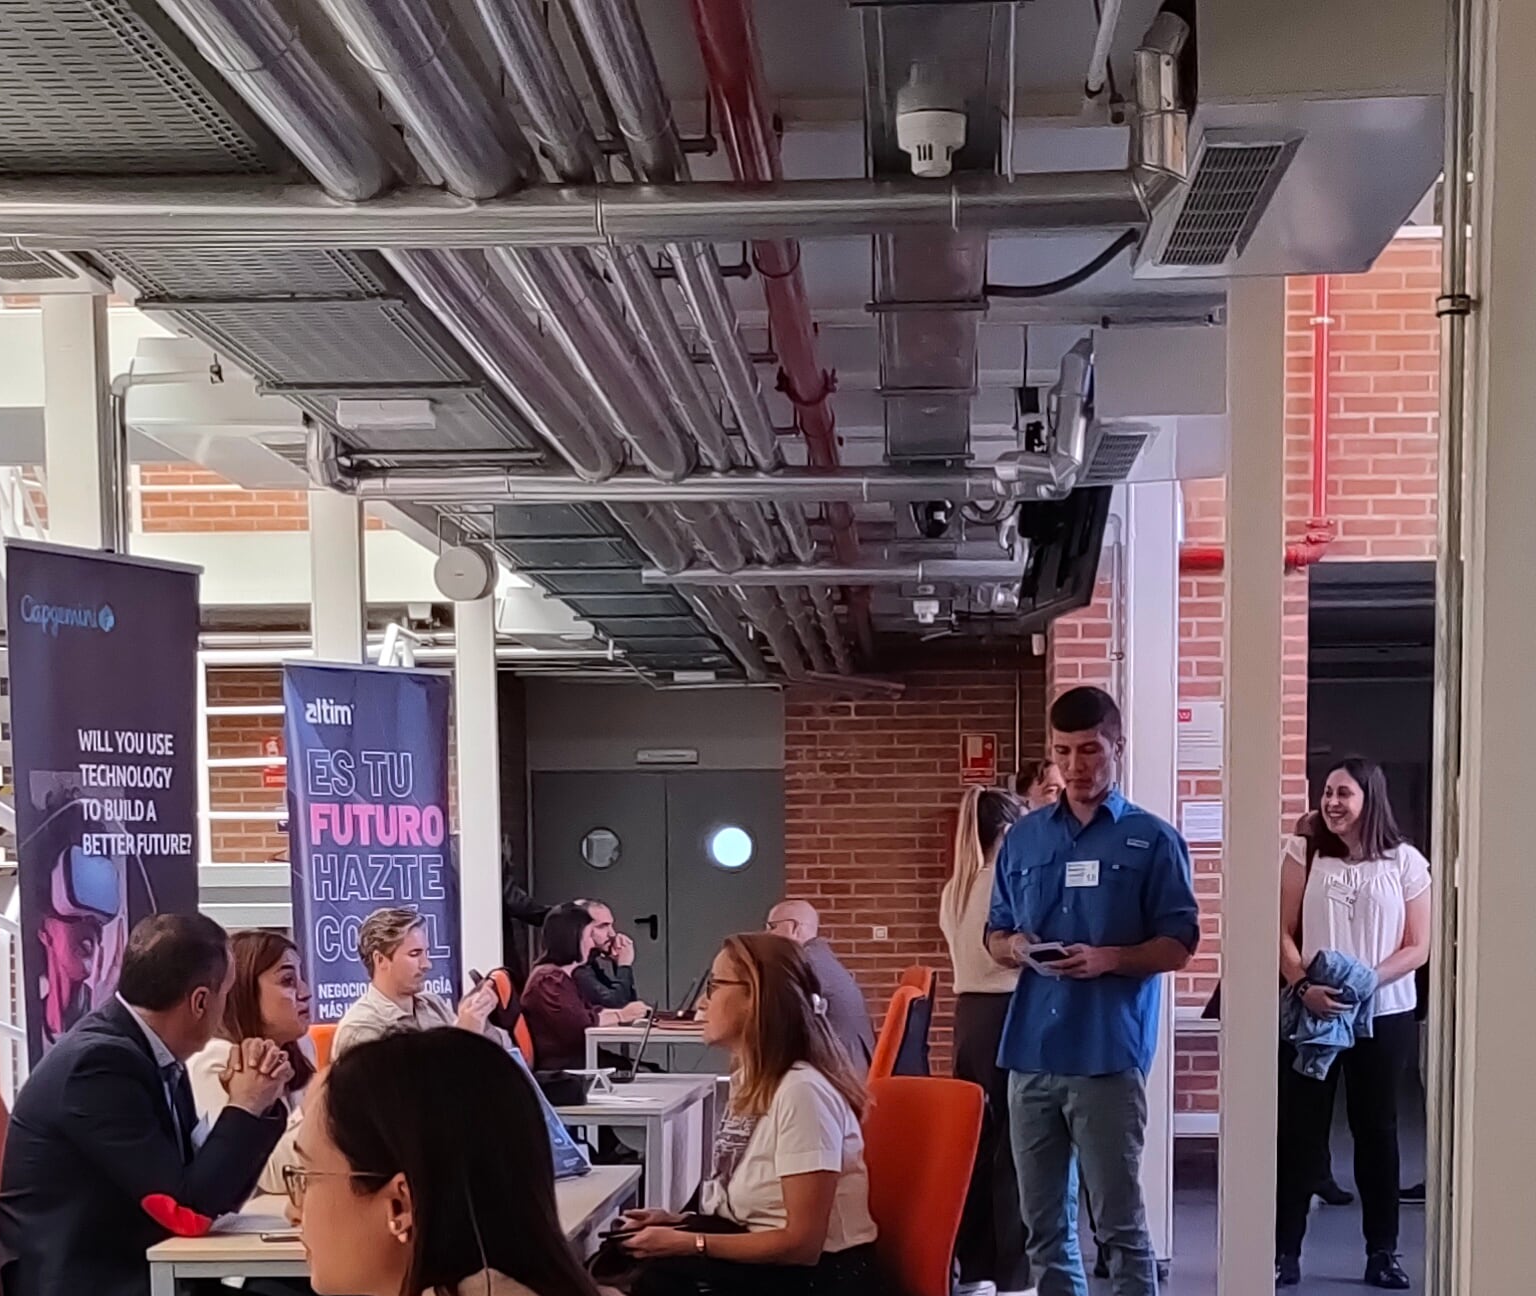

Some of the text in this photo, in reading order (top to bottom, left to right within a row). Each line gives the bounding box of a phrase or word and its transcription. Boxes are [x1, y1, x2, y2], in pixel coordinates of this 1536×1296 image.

[20, 594, 98, 637] Capgemini
[305, 698, 352, 725] altim
[77, 729, 174, 755] WILL YOU USE
[79, 764, 172, 788] TECHNOLOGY
[307, 749, 413, 797] ES TU
[79, 799, 157, 821] TO BUILD A
[310, 803, 445, 847] FUTURO
[82, 833, 192, 856] BETTER FUTURE?
[312, 854, 445, 900] HAZTE
[315, 915, 364, 962] CO
[318, 1001, 343, 1019] MÁS
